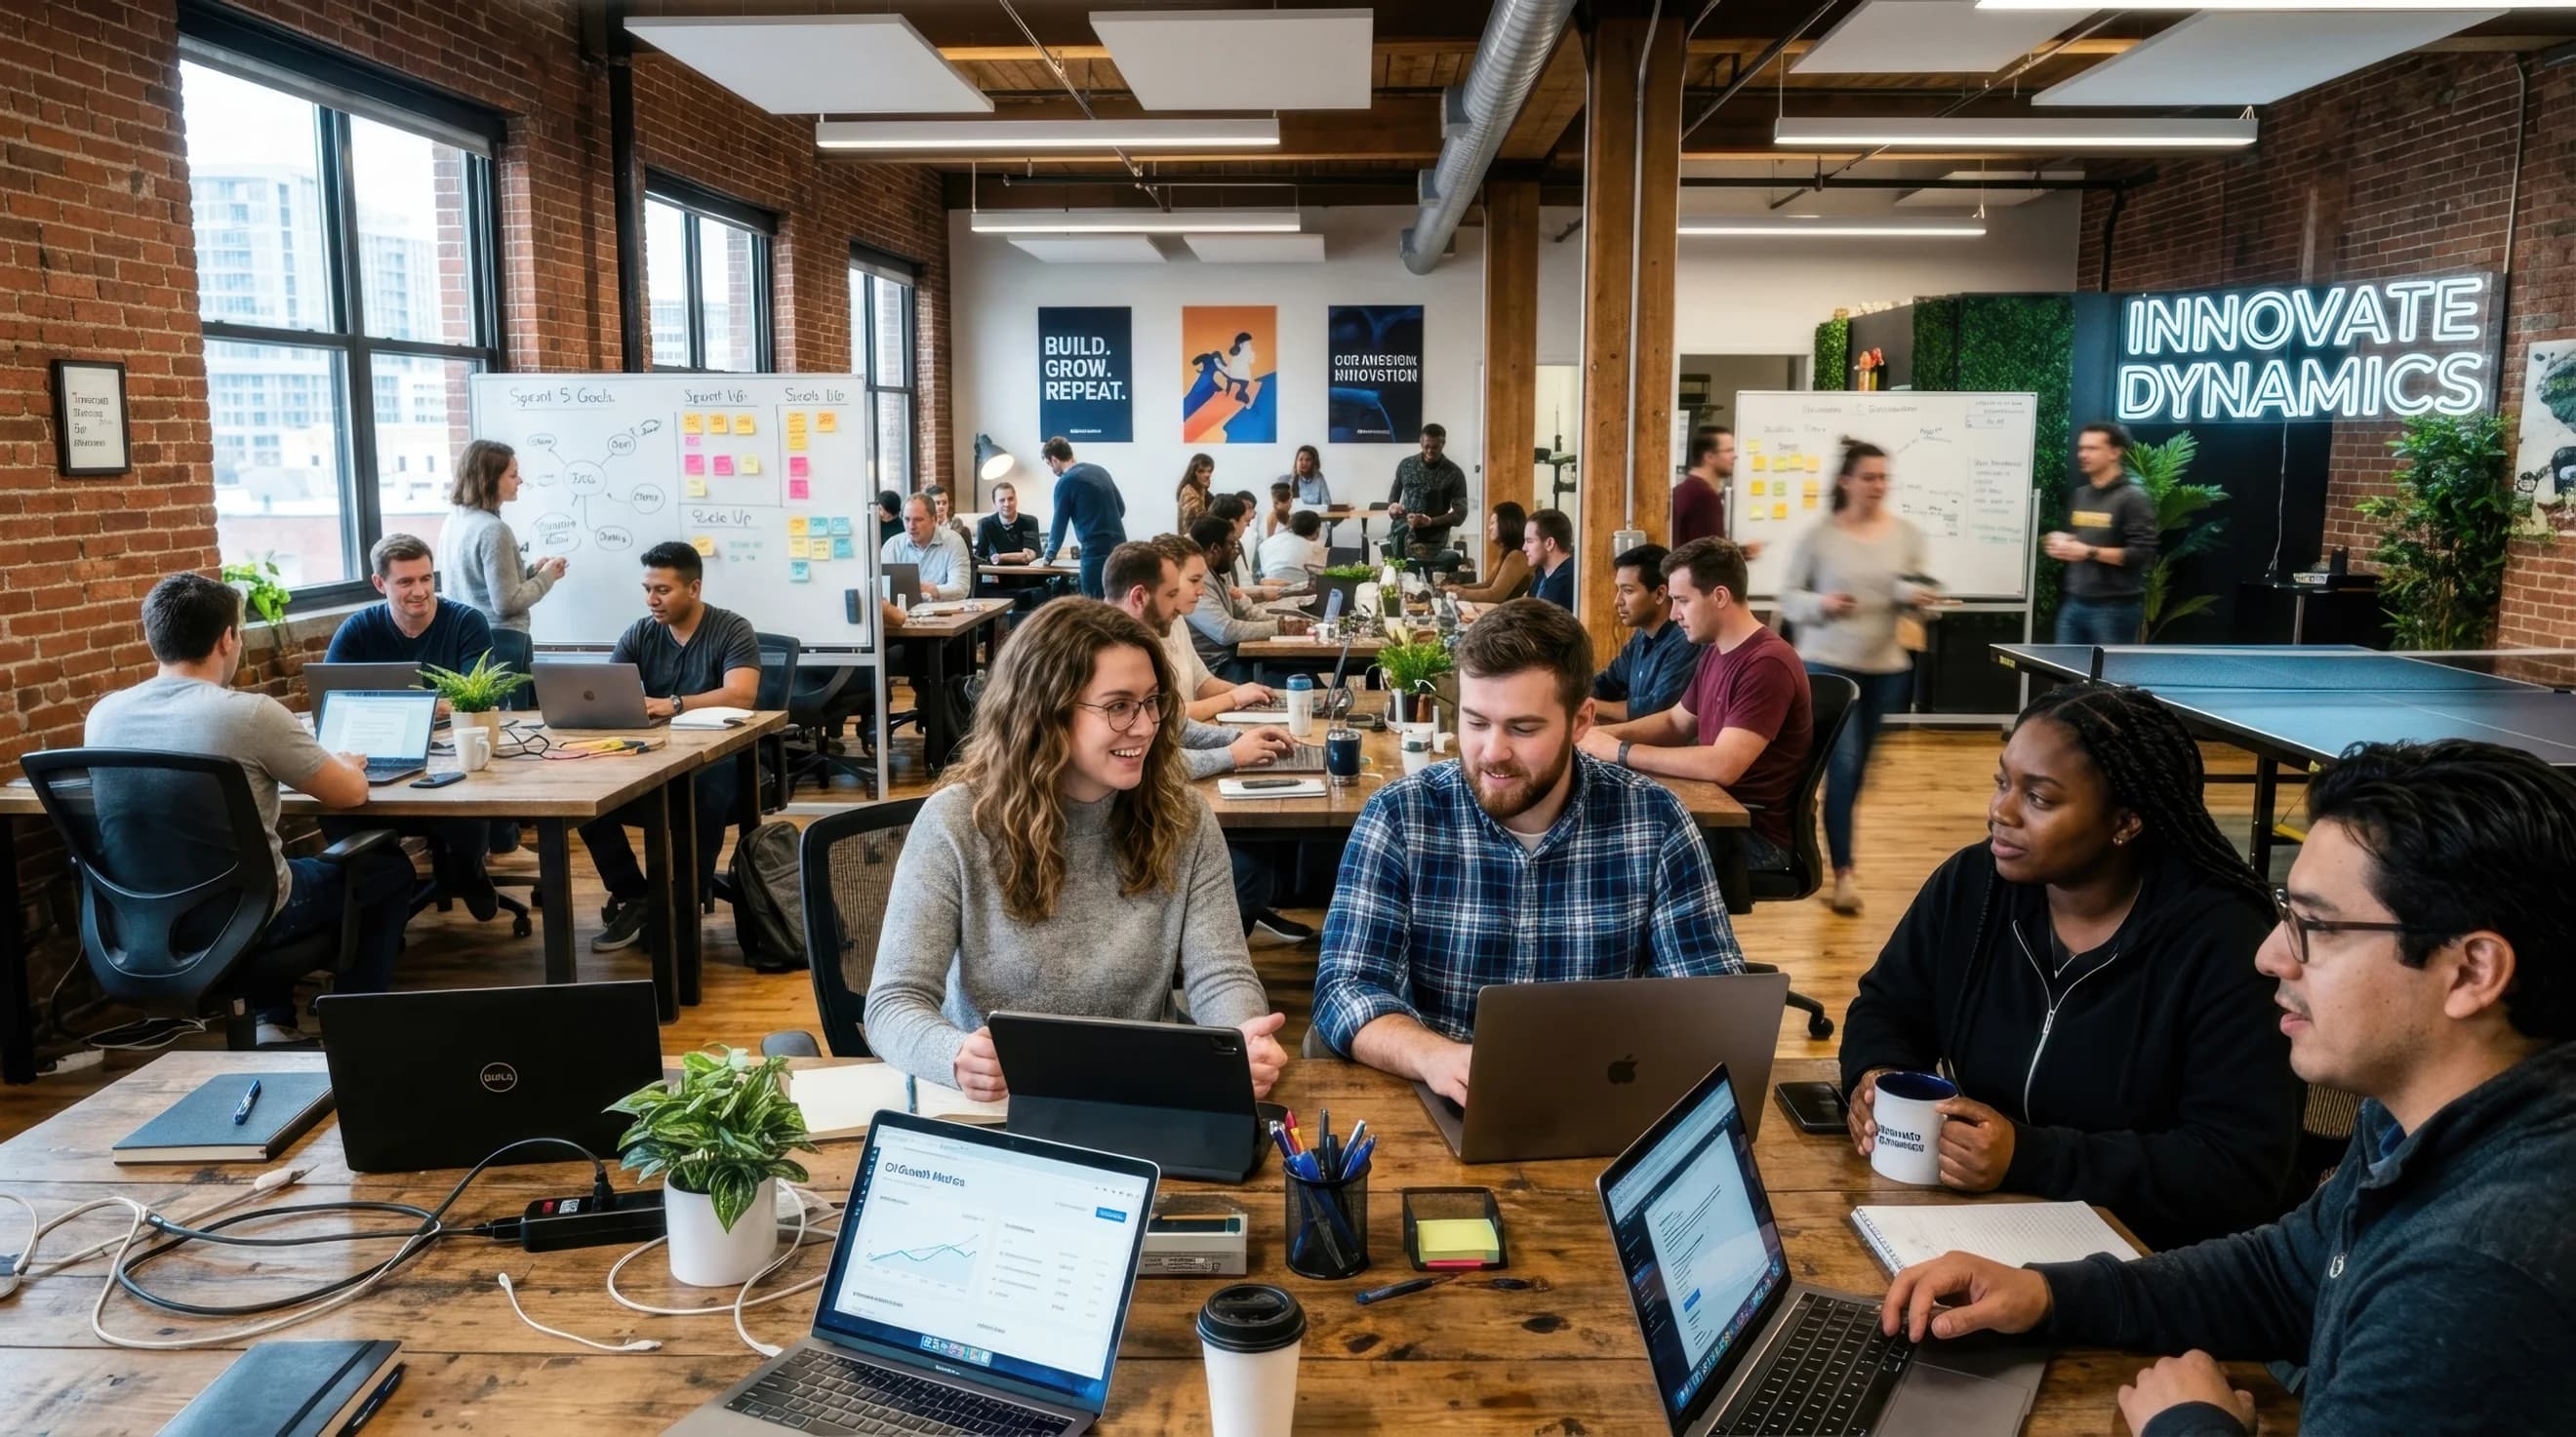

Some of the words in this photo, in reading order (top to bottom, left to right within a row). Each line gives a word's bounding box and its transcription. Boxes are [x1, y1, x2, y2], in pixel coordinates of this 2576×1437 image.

[2126, 276, 2483, 356] INNOVATE
[1045, 336, 1111, 355] BUILD.
[1045, 358, 1112, 379] GROW.
[1045, 380, 1127, 401] REPEAT.
[2116, 351, 2484, 420] DYNAMICS
